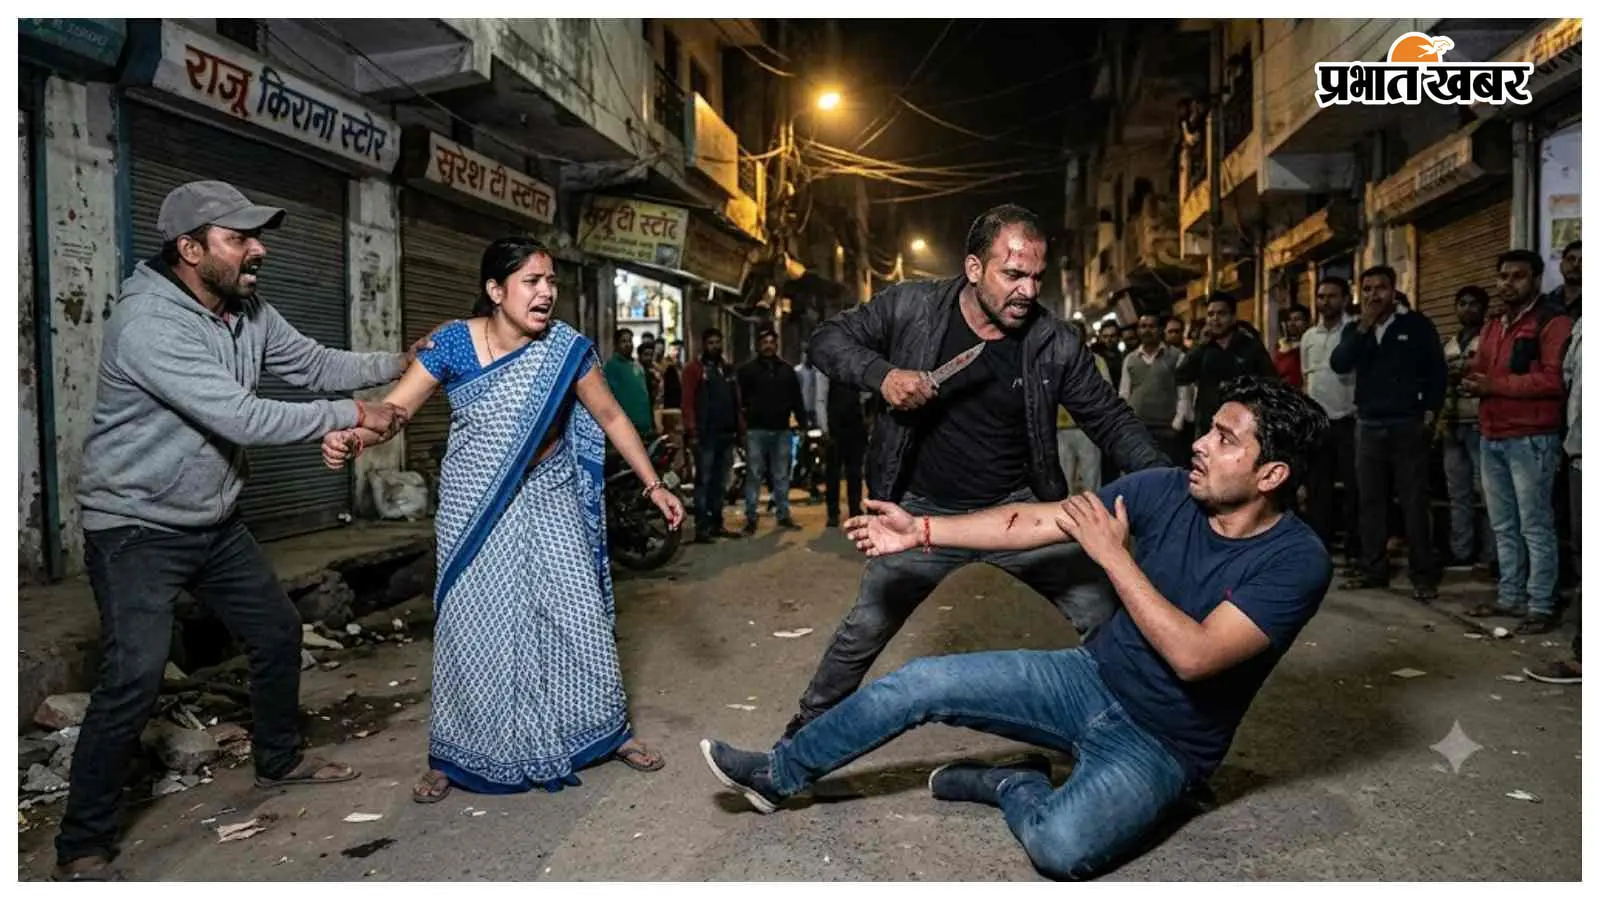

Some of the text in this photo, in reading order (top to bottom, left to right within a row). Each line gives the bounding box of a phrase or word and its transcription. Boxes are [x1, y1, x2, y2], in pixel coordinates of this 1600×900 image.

[184, 44, 387, 161] राजू किराना स्टोर
[436, 144, 486, 192] सुरेश
[489, 166, 507, 199] टी
